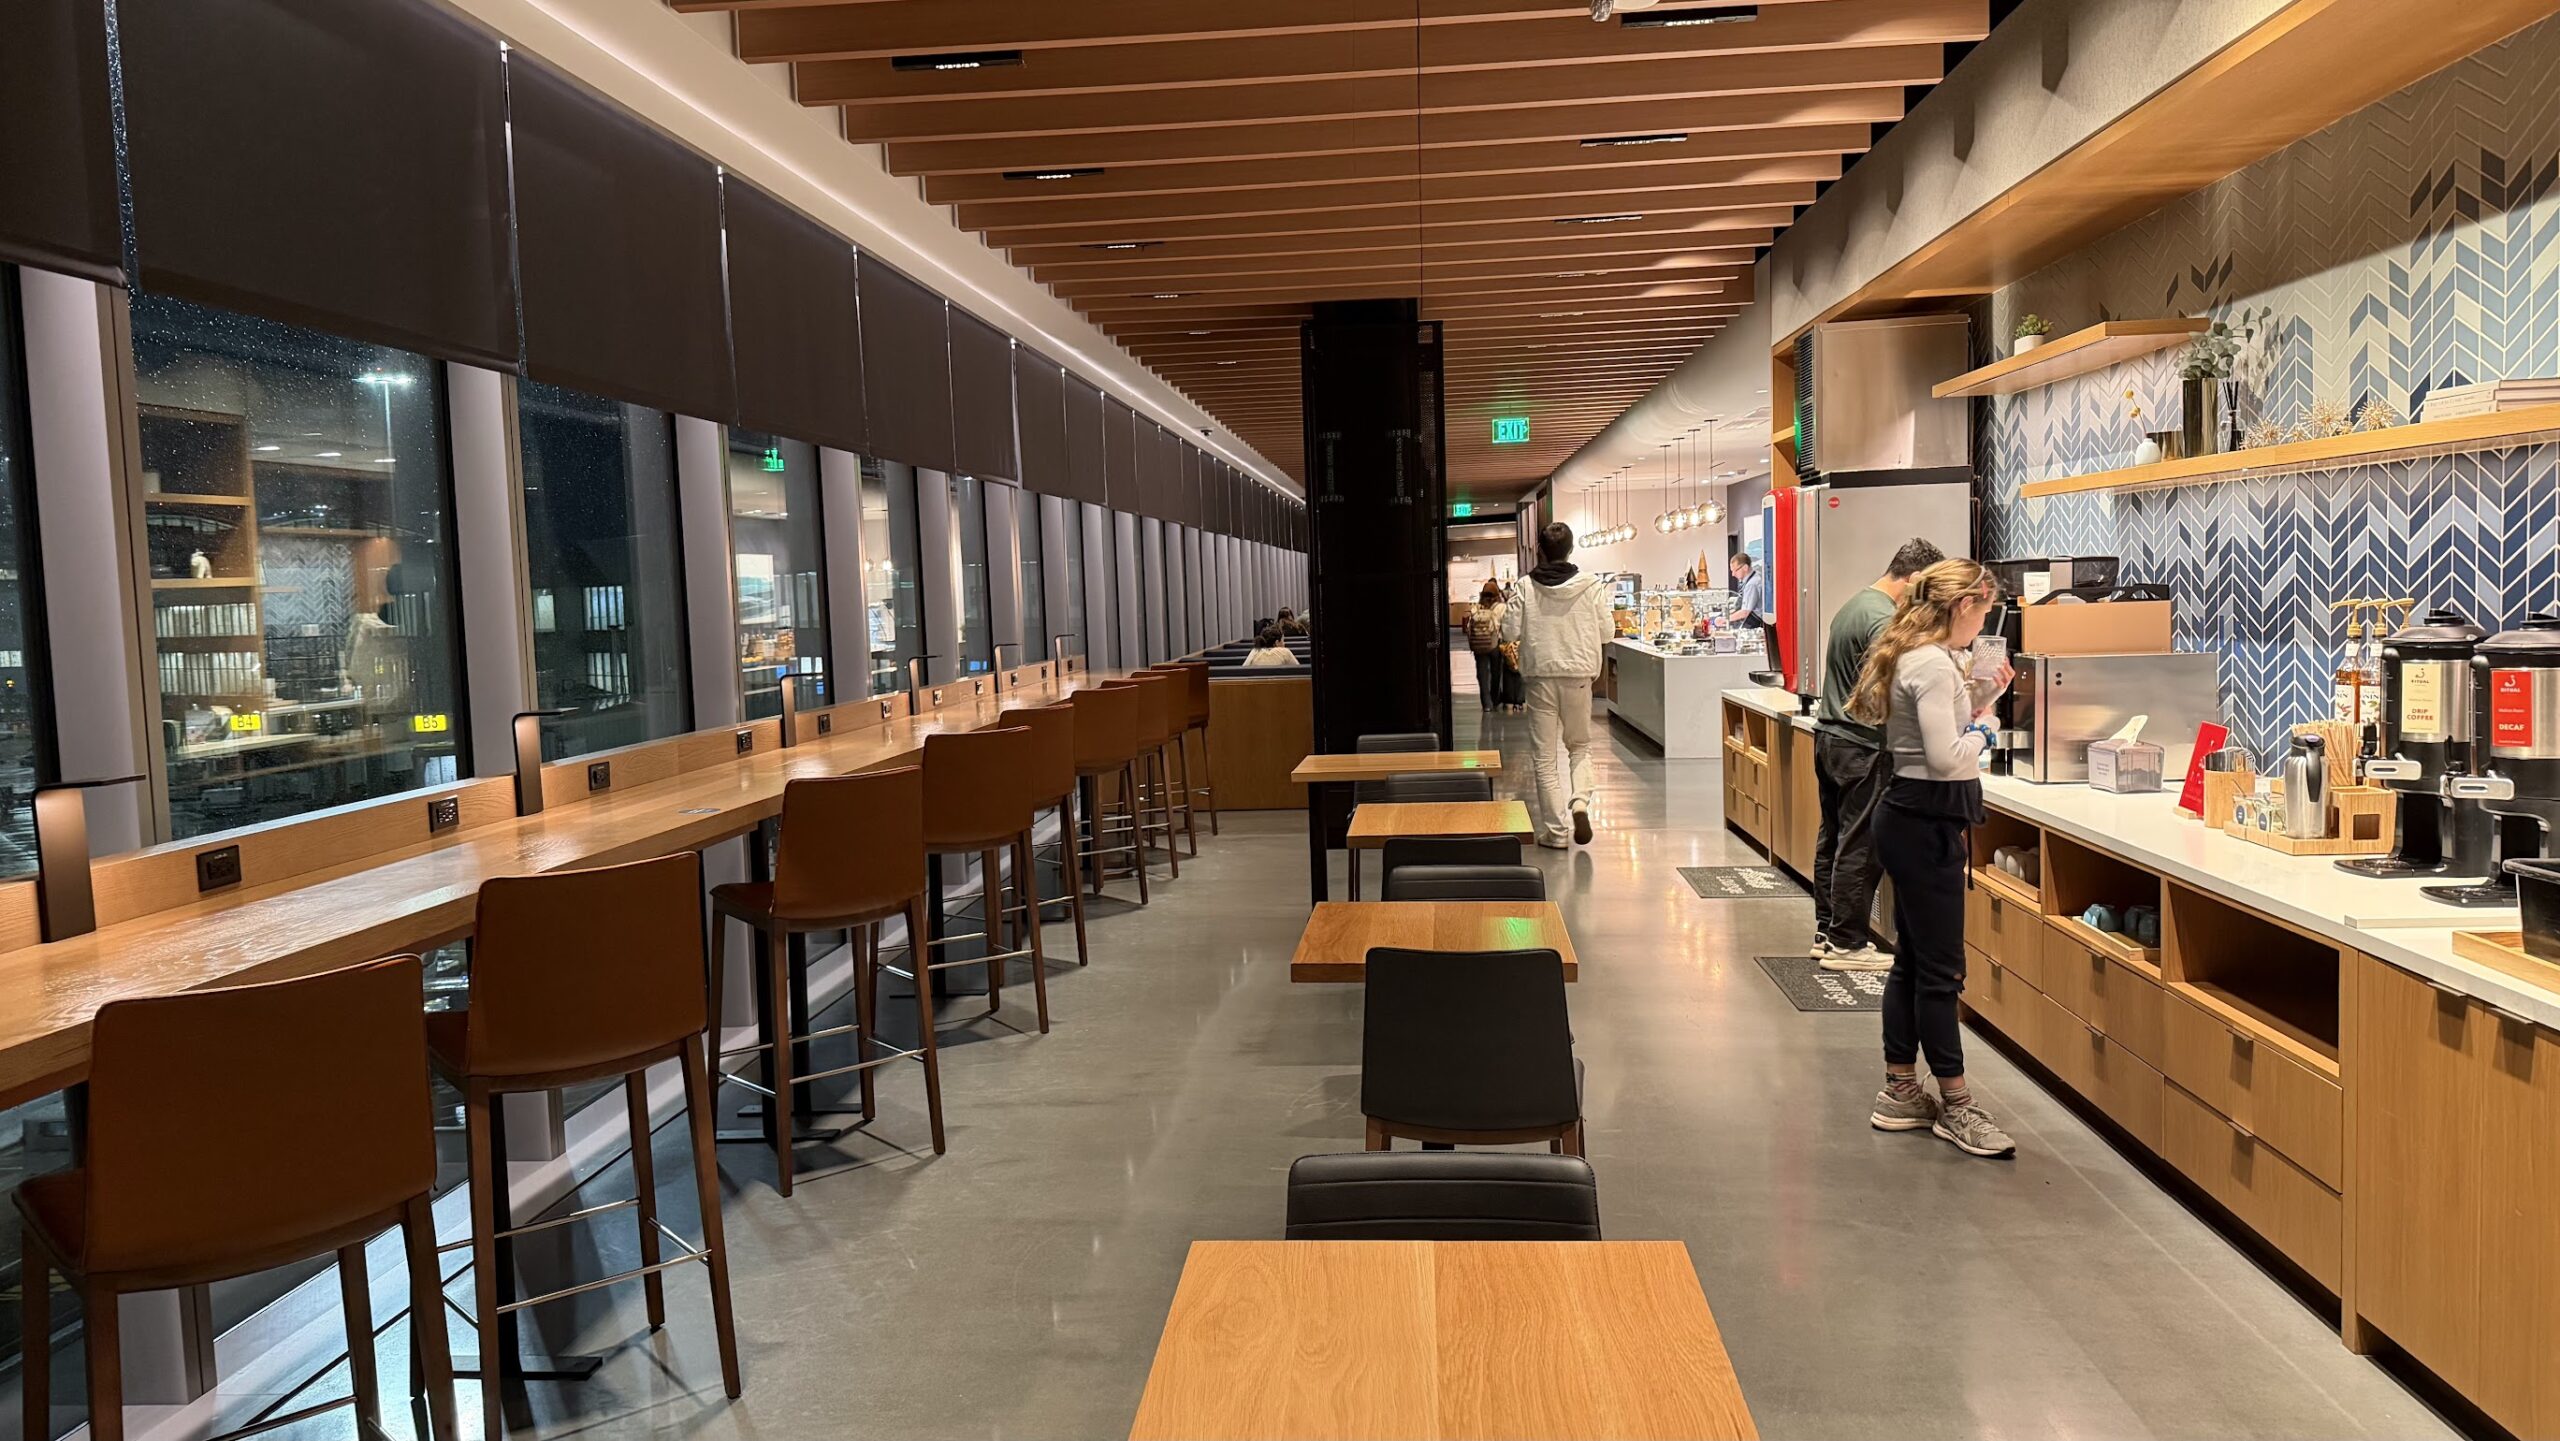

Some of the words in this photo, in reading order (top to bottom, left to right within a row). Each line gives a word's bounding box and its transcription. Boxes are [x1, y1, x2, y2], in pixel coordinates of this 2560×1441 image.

[1497, 420, 1526, 441] EXIT
[237, 714, 253, 729] B4
[423, 714, 438, 729] B5
[2498, 723, 2526, 731] DECAF
[1812, 974, 1858, 1006] Lounge
